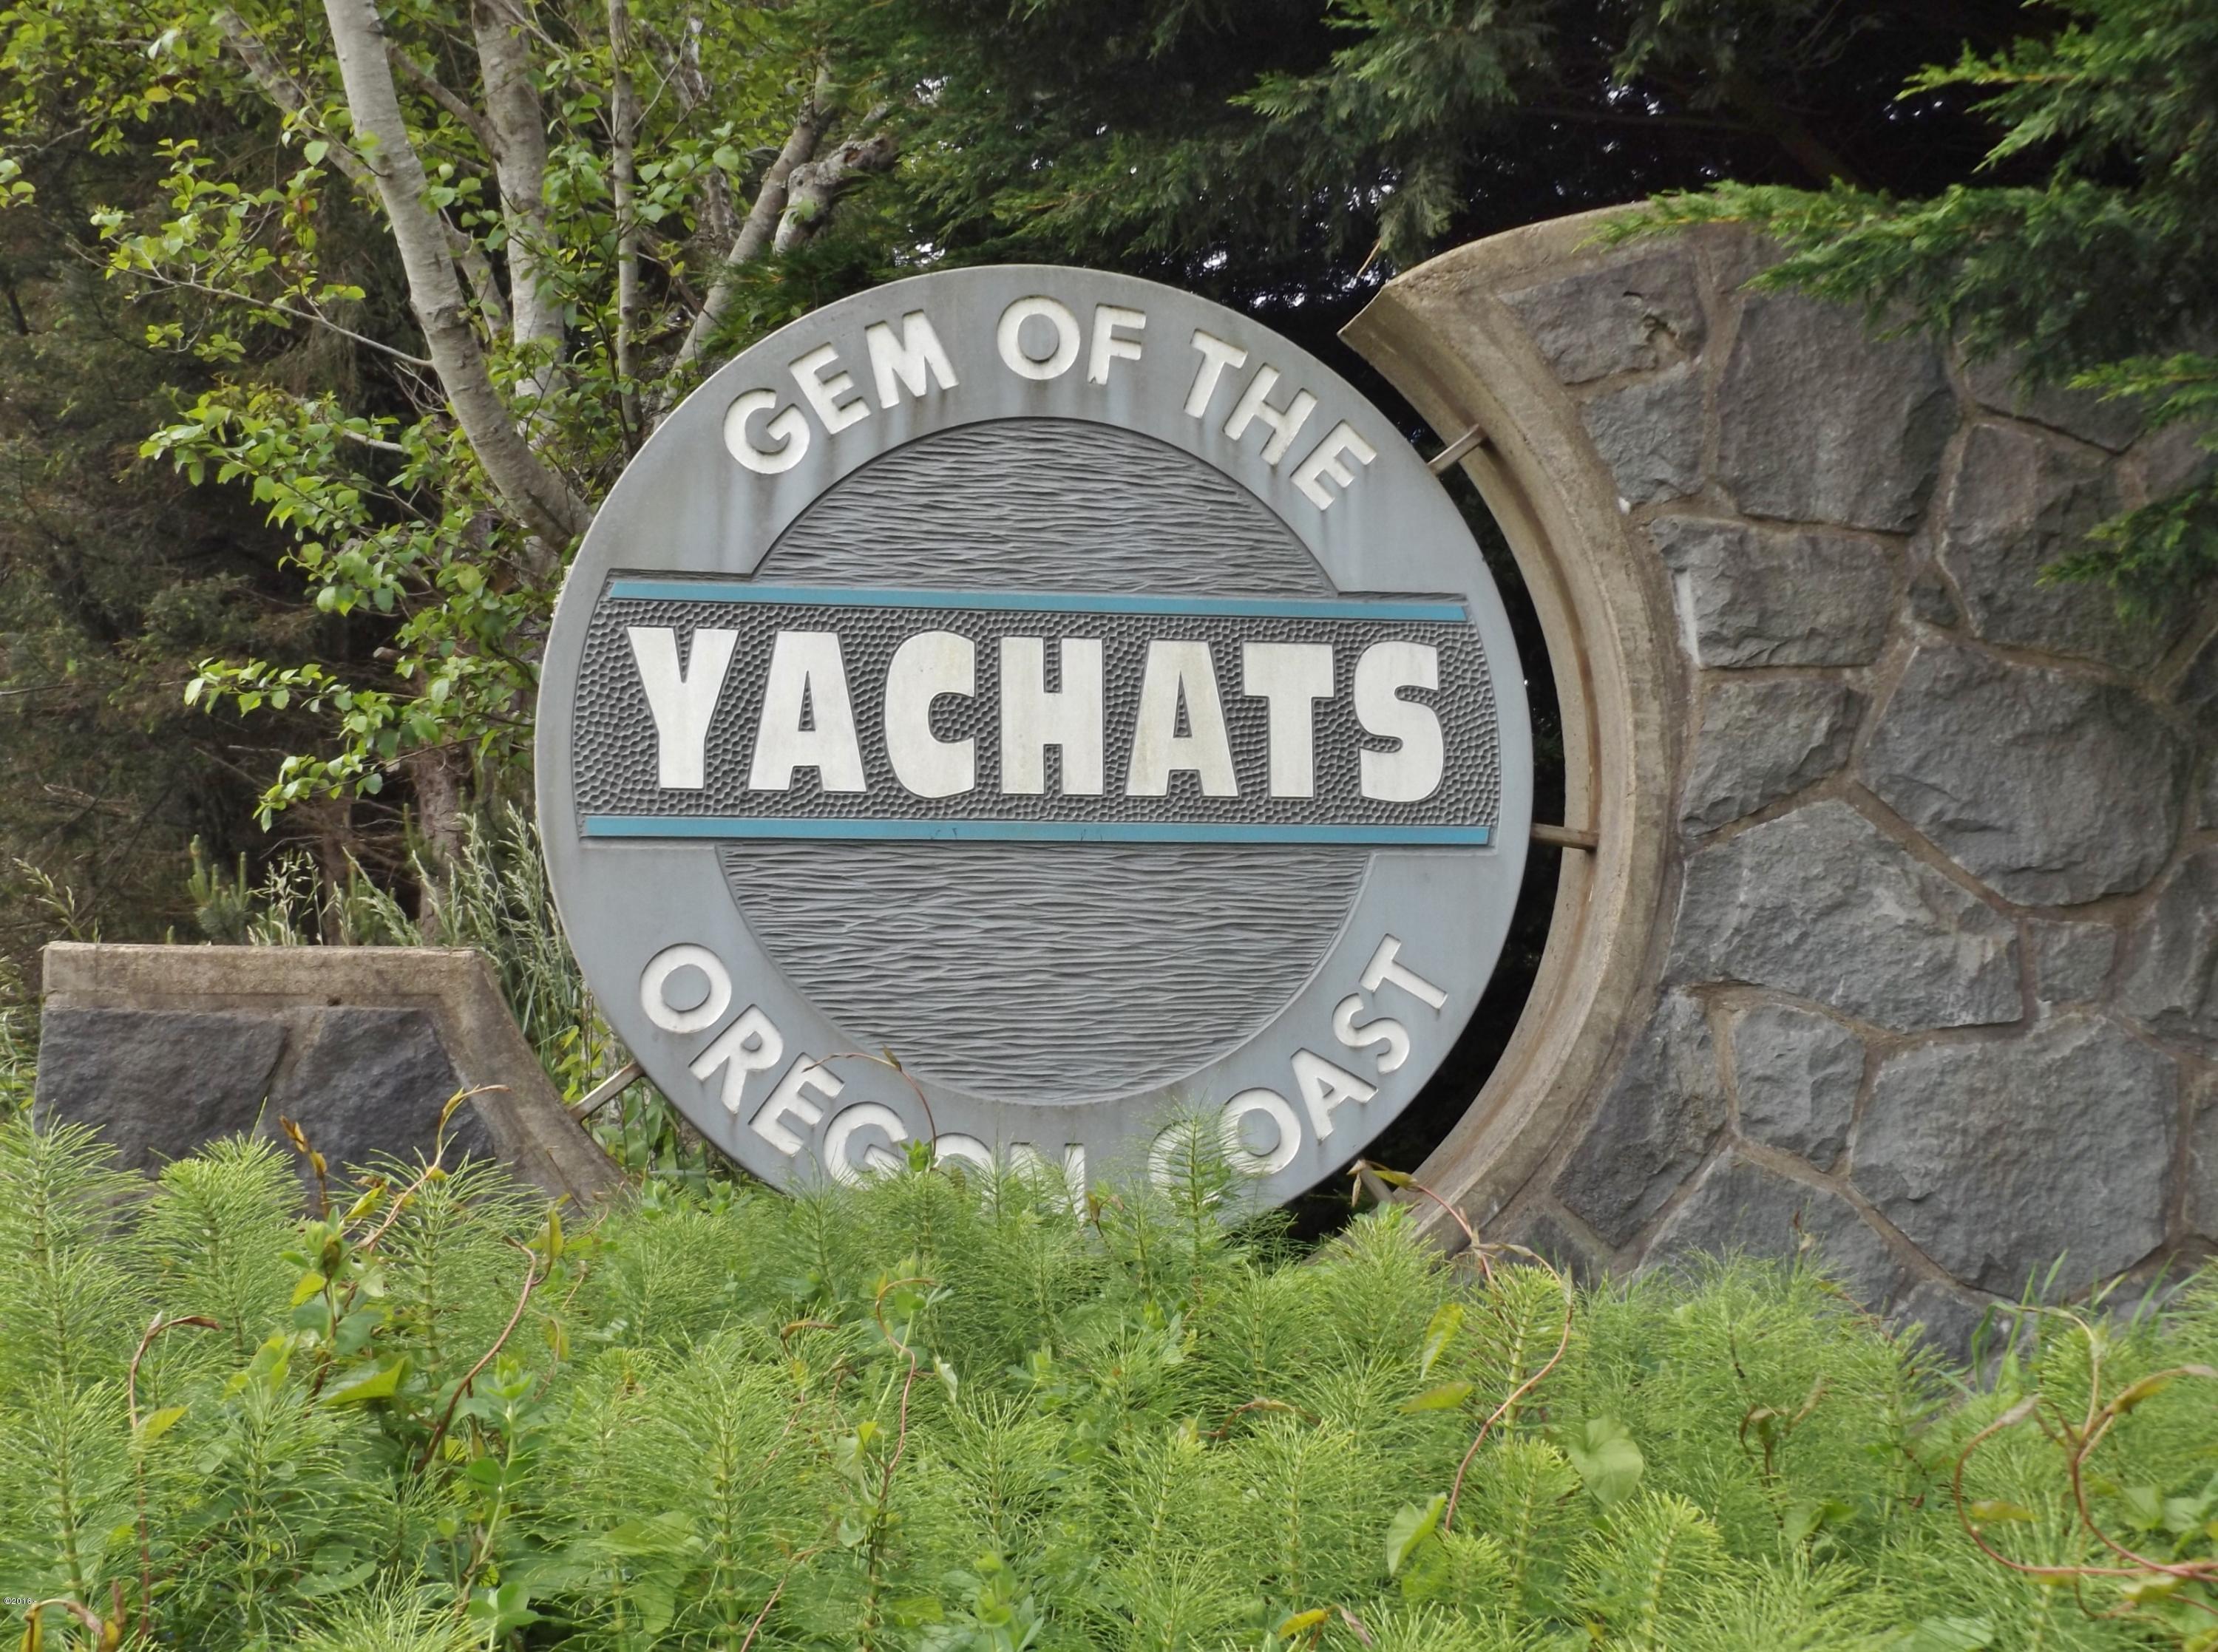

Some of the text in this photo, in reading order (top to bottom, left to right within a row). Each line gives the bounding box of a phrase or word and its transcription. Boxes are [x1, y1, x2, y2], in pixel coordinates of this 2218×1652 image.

[723, 296, 1377, 511] GEM OF THE
[626, 625, 1446, 803] YACHATS
[1147, 933, 1448, 1207] COAST
